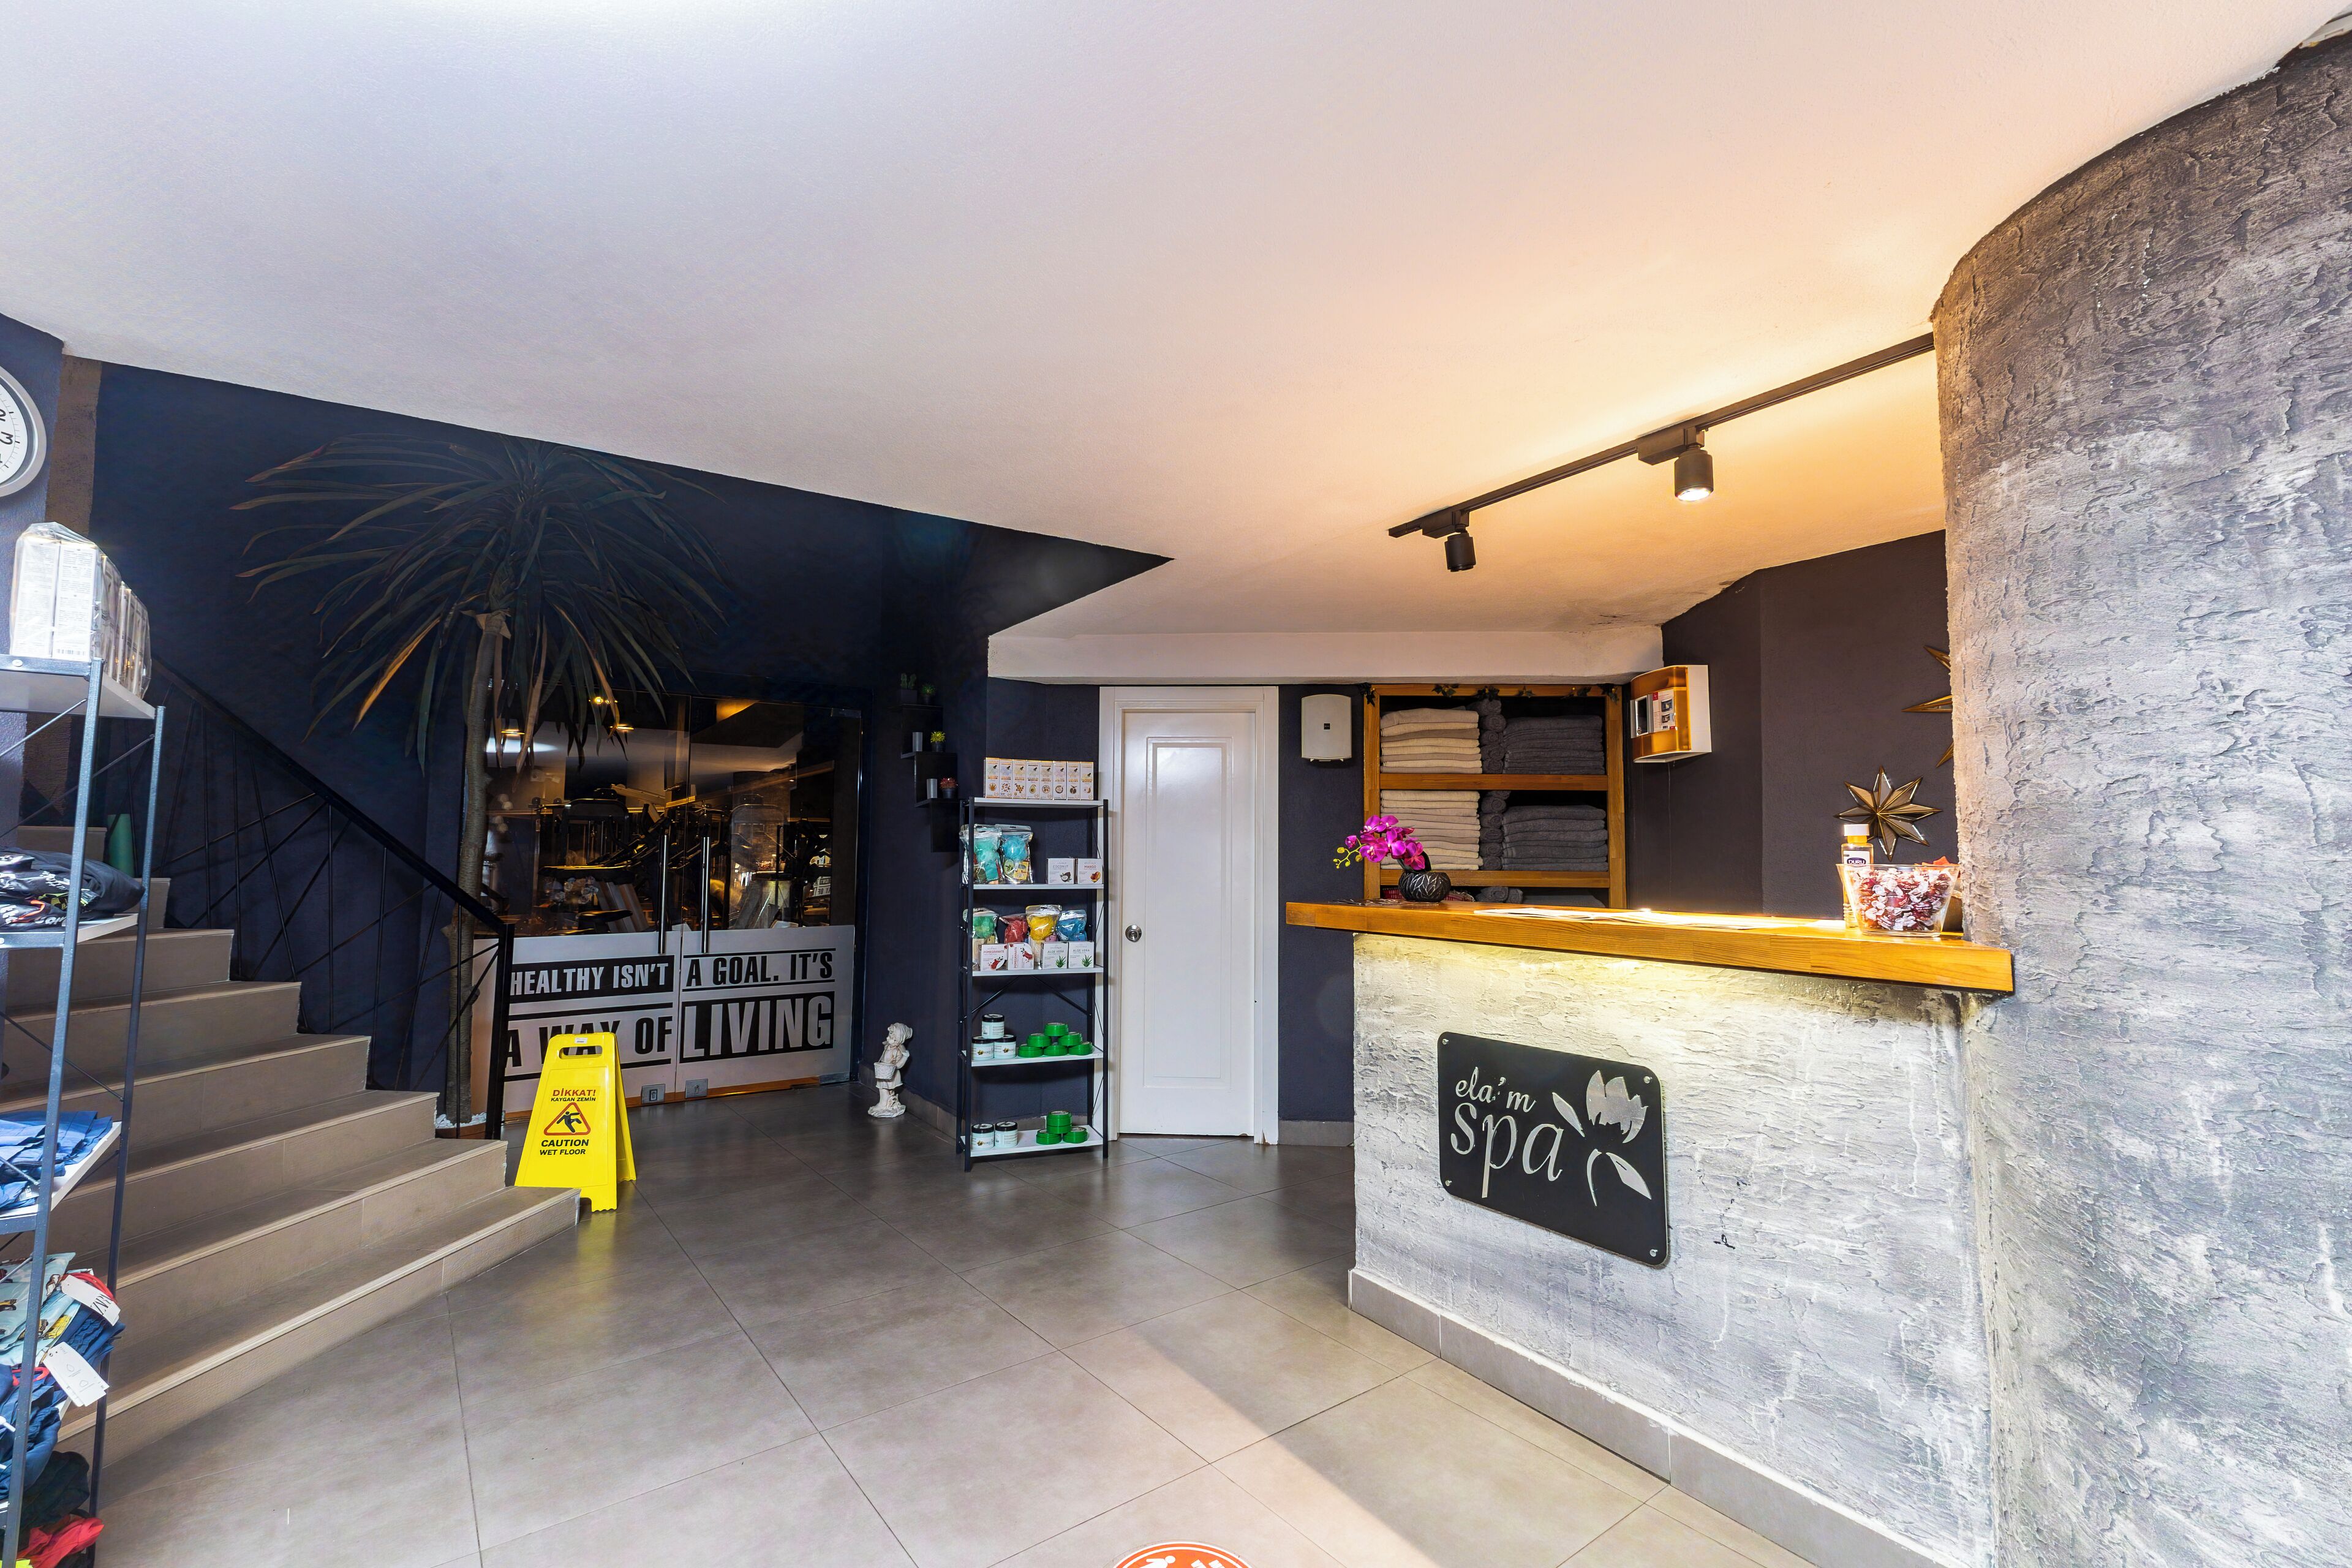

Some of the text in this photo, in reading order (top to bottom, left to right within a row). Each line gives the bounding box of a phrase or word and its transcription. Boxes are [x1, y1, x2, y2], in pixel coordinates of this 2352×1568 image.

[0, 431, 13, 445] 3
[510, 952, 832, 996] HEALTHY ISN'T A GOAL. IT'S
[505, 1029, 521, 1068] A
[635, 1016, 673, 1055] OF
[683, 995, 832, 1058] LIVING
[553, 1088, 596, 1096] DİKKAT!
